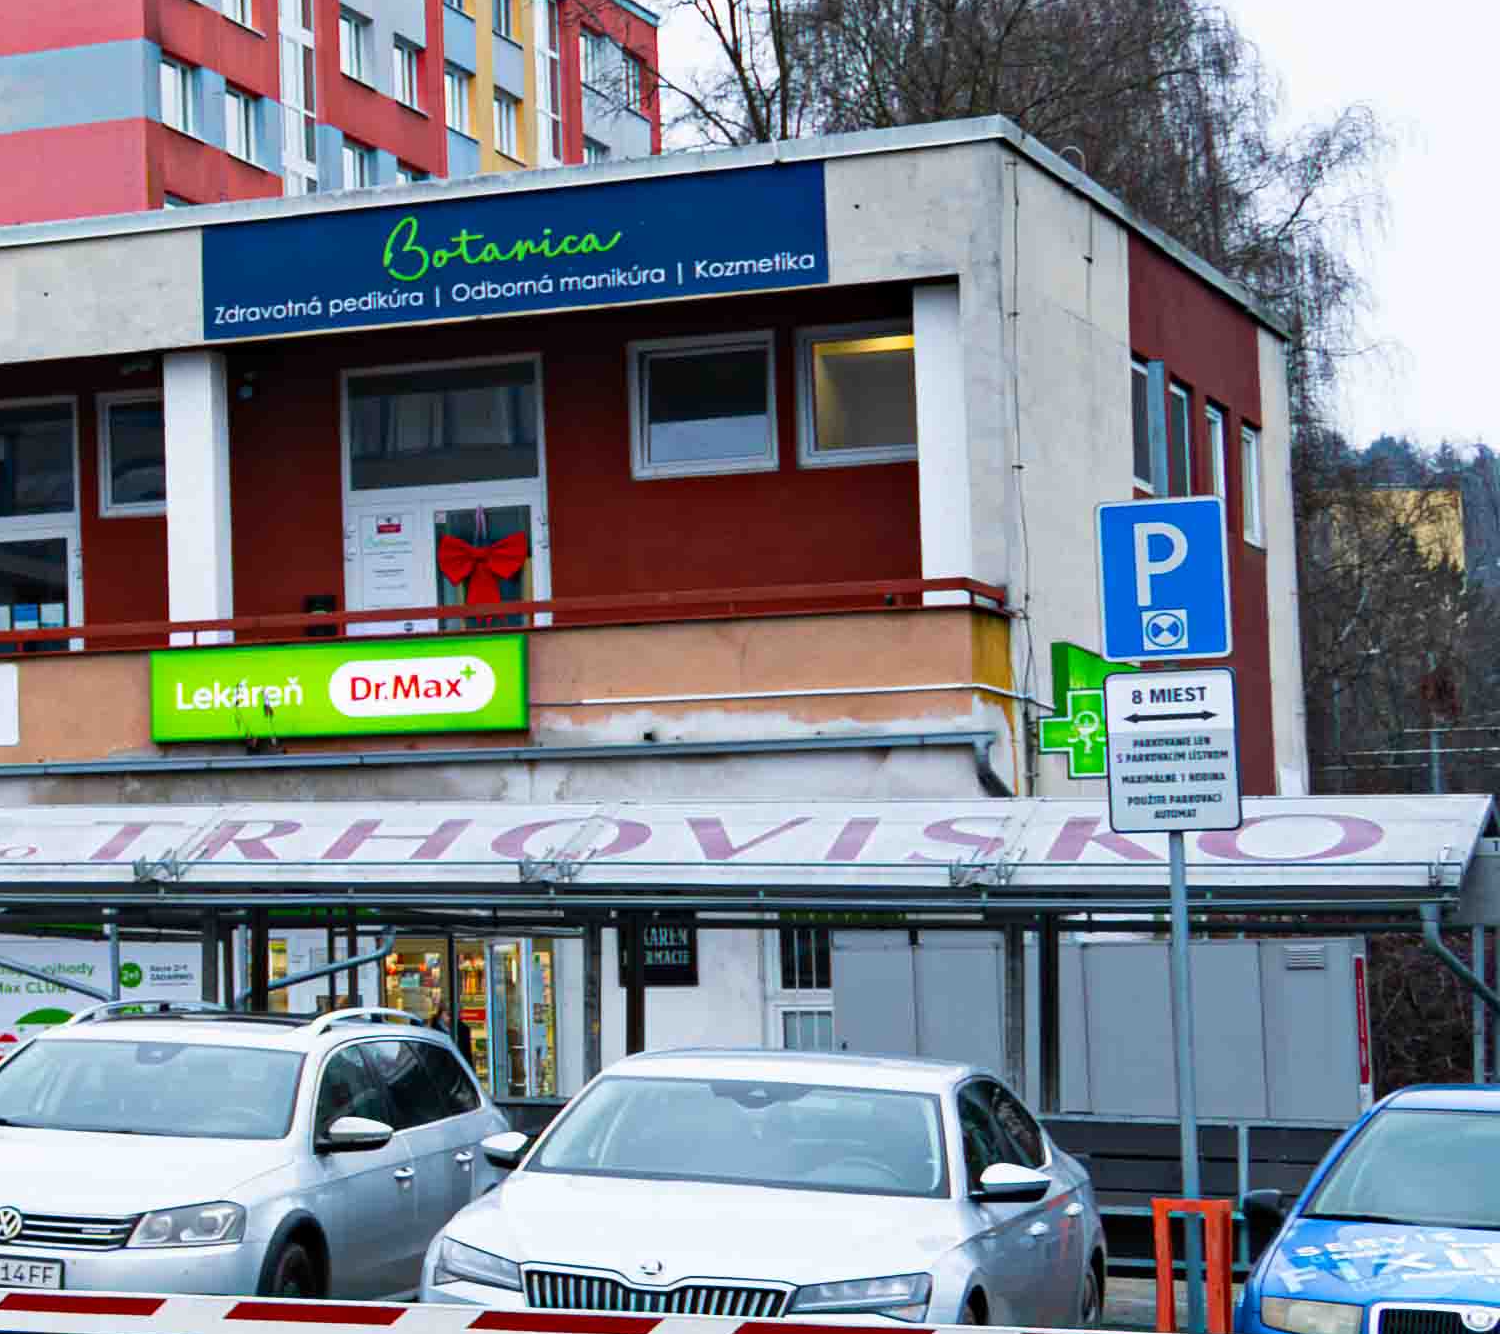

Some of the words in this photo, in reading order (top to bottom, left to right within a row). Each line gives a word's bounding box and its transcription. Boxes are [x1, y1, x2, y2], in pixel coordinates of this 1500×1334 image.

[383, 216, 623, 282] Botanica
[214, 296, 322, 324] Zdravotná
[329, 288, 424, 317] pedikúra
[451, 275, 553, 302] Odborná
[560, 266, 665, 292] manikúra
[694, 250, 815, 279] Kozmetika
[1133, 522, 1188, 607] P
[175, 676, 304, 711] Lekáreň
[349, 674, 462, 702] Dr.Max
[1132, 690, 1143, 705] 8
[1150, 687, 1208, 704] MIEST
[1132, 737, 1191, 748] PARKOVANIE
